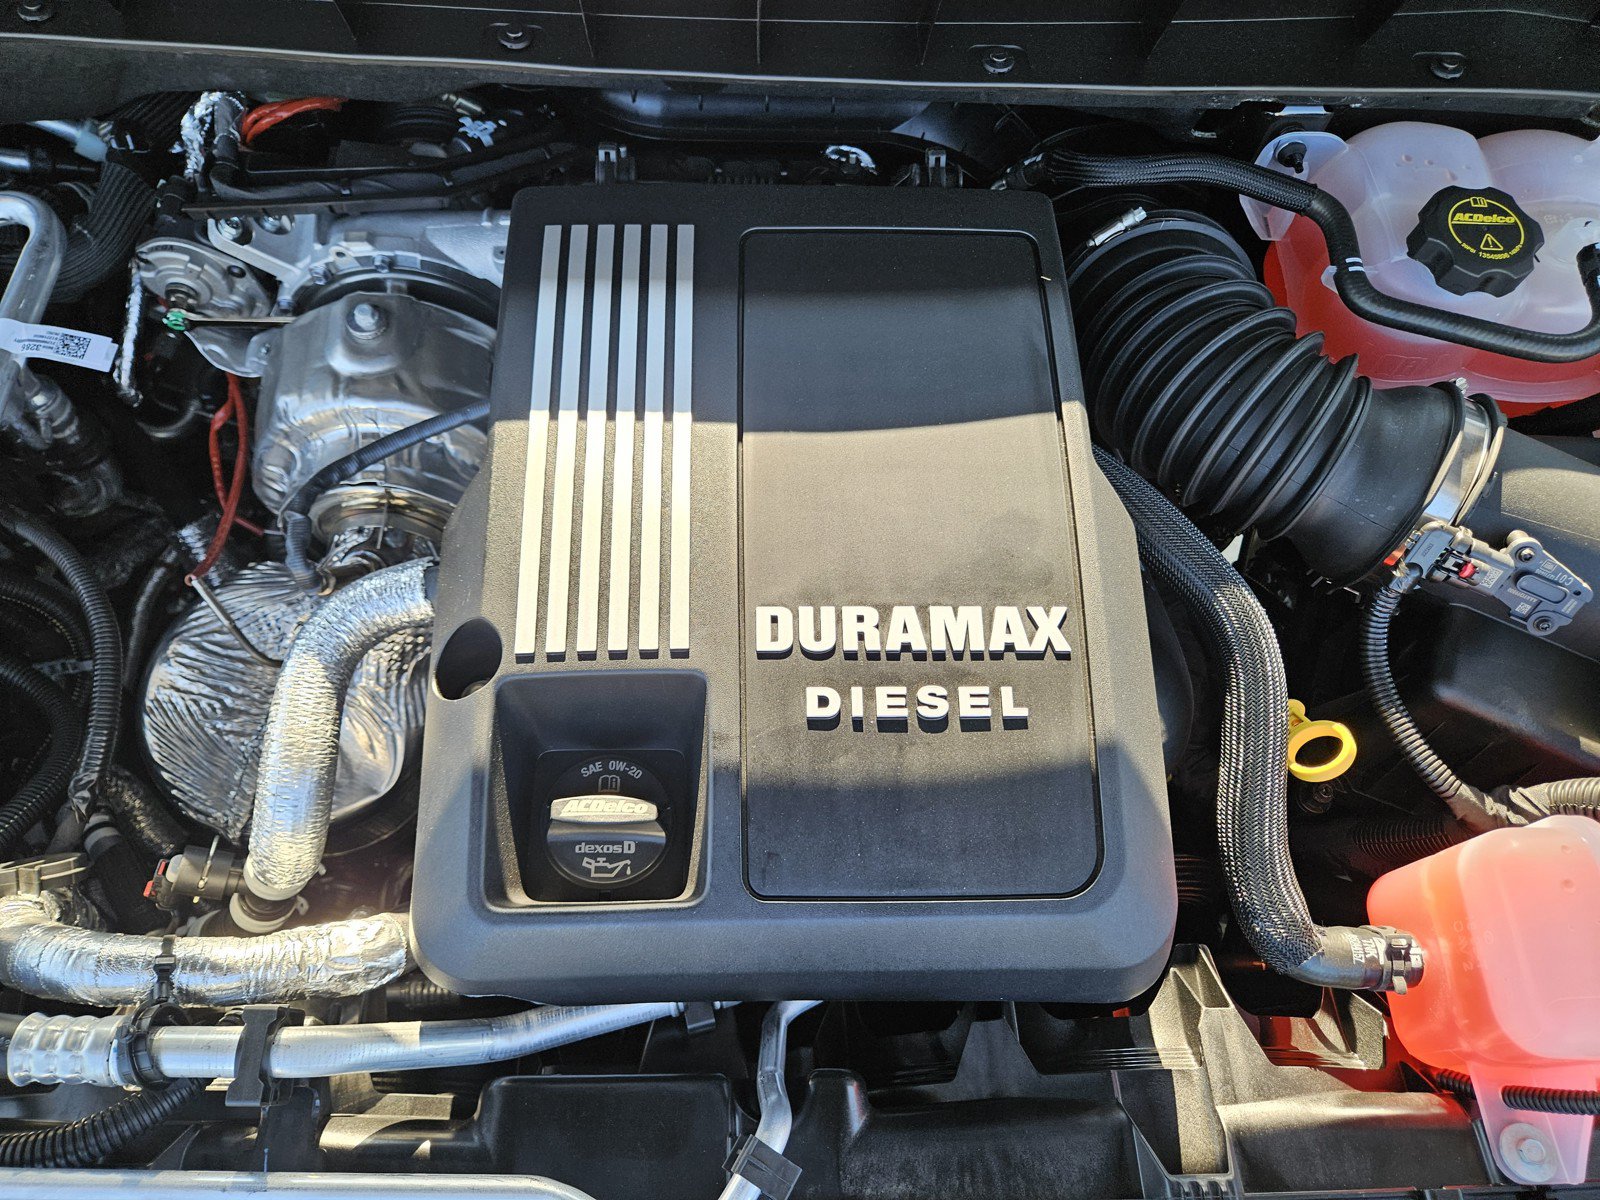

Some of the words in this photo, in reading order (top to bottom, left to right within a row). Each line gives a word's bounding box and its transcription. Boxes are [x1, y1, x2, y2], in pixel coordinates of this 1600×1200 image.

[1453, 212, 1516, 224] ACDelco
[755, 605, 1072, 657] DURAMAX
[805, 685, 1030, 729] DIESEL
[580, 761, 603, 778] SAE
[608, 760, 643, 780] 0W-20
[562, 799, 649, 814] ACDelco
